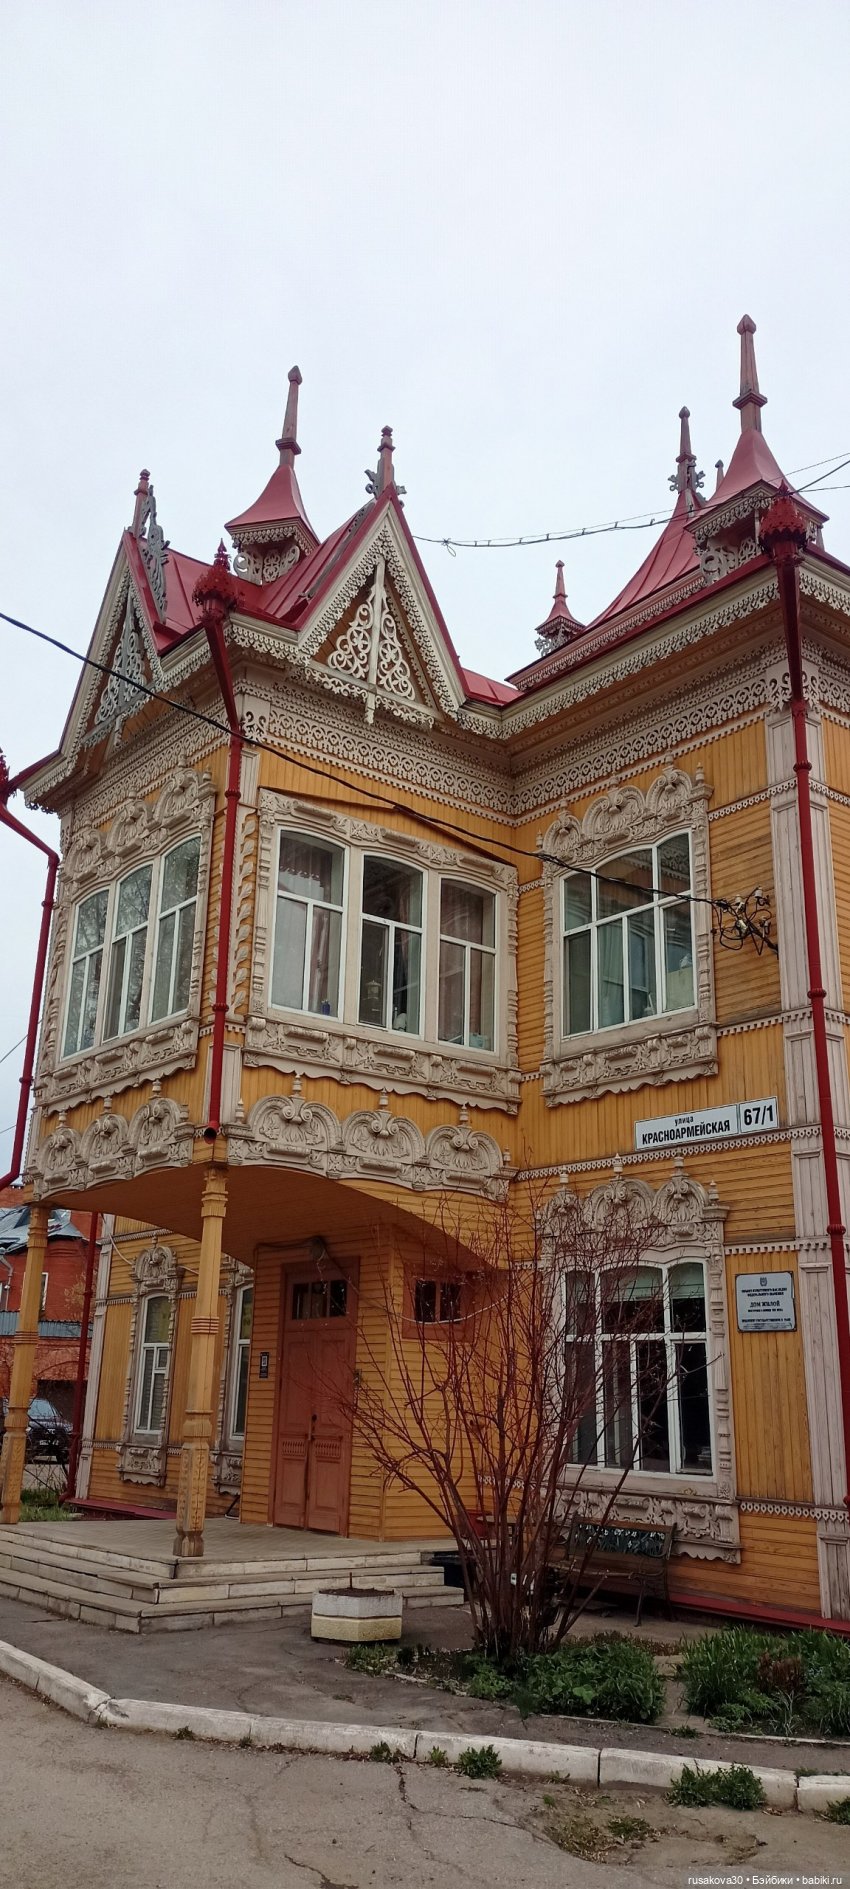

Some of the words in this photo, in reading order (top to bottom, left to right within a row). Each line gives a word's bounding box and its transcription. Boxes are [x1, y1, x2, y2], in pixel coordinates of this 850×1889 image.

[674, 1116, 694, 1127] улица
[744, 1105, 773, 1126] 67/1
[642, 1120, 730, 1145] КРАСНОАРМЕЙСКАЯ
